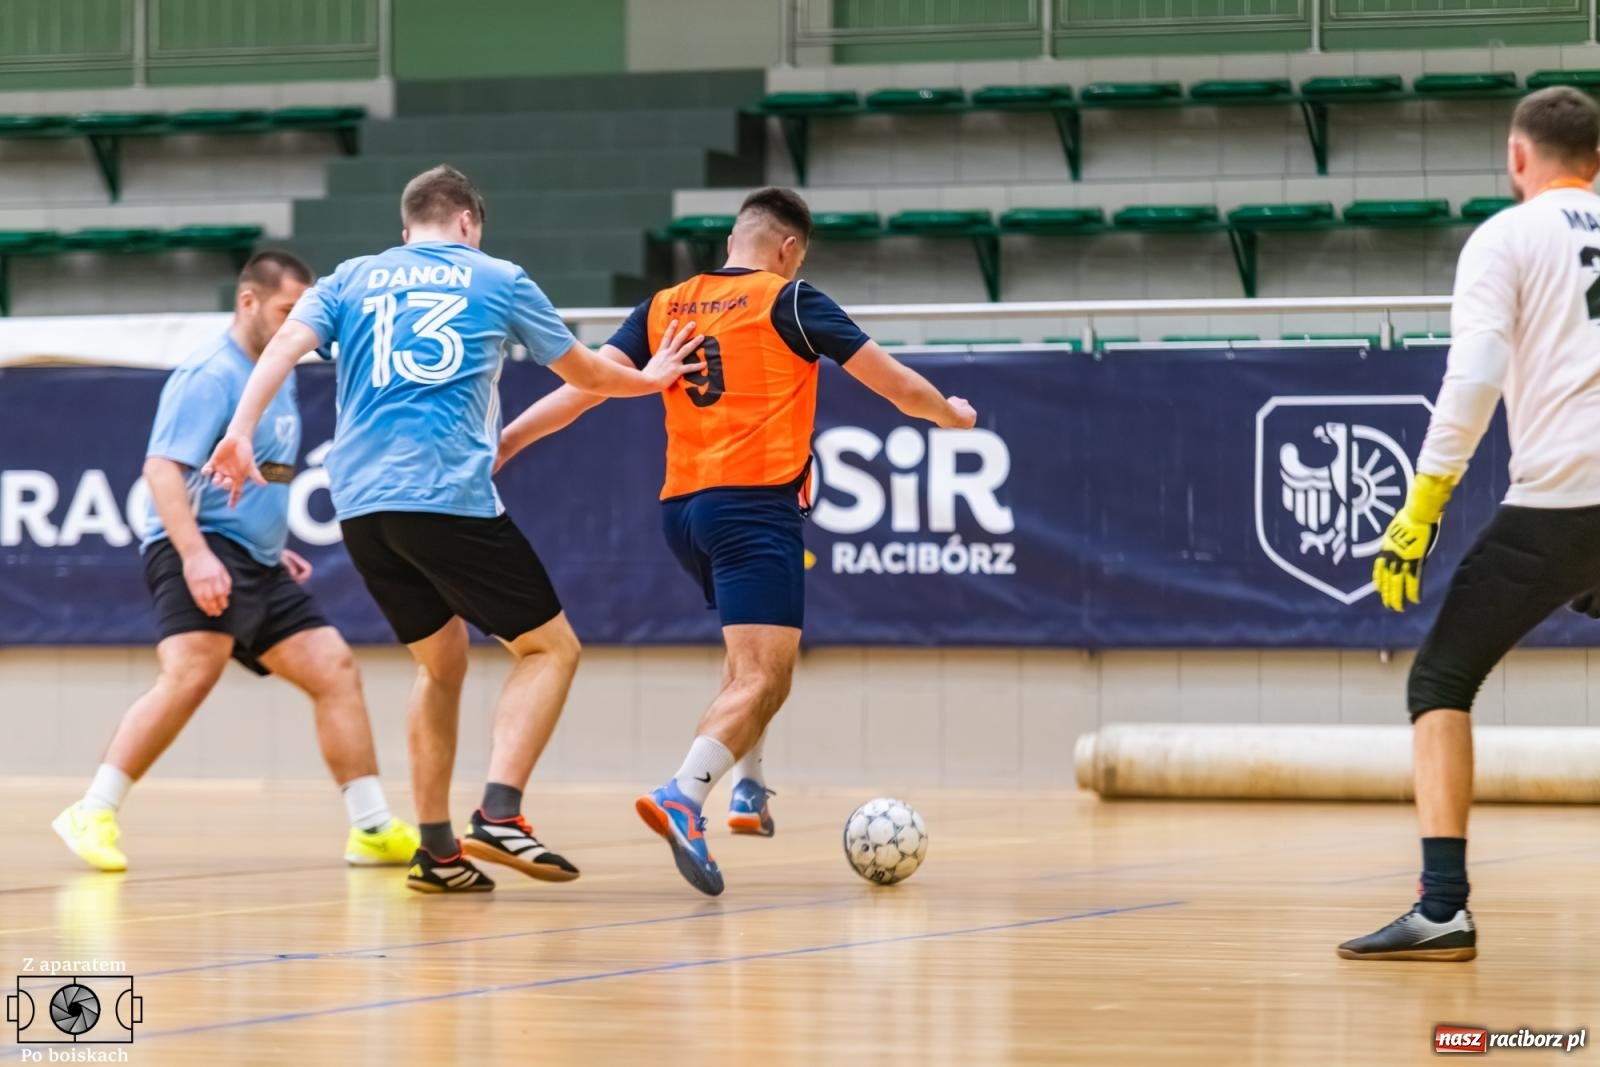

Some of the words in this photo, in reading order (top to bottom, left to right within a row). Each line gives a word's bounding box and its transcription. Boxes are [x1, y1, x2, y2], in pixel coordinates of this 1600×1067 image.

[368, 265, 472, 288] DANON
[362, 291, 468, 388] 13
[682, 335, 726, 408] 9
[810, 426, 1015, 534] SiR
[832, 533, 1016, 575] RACIBÓRZ
